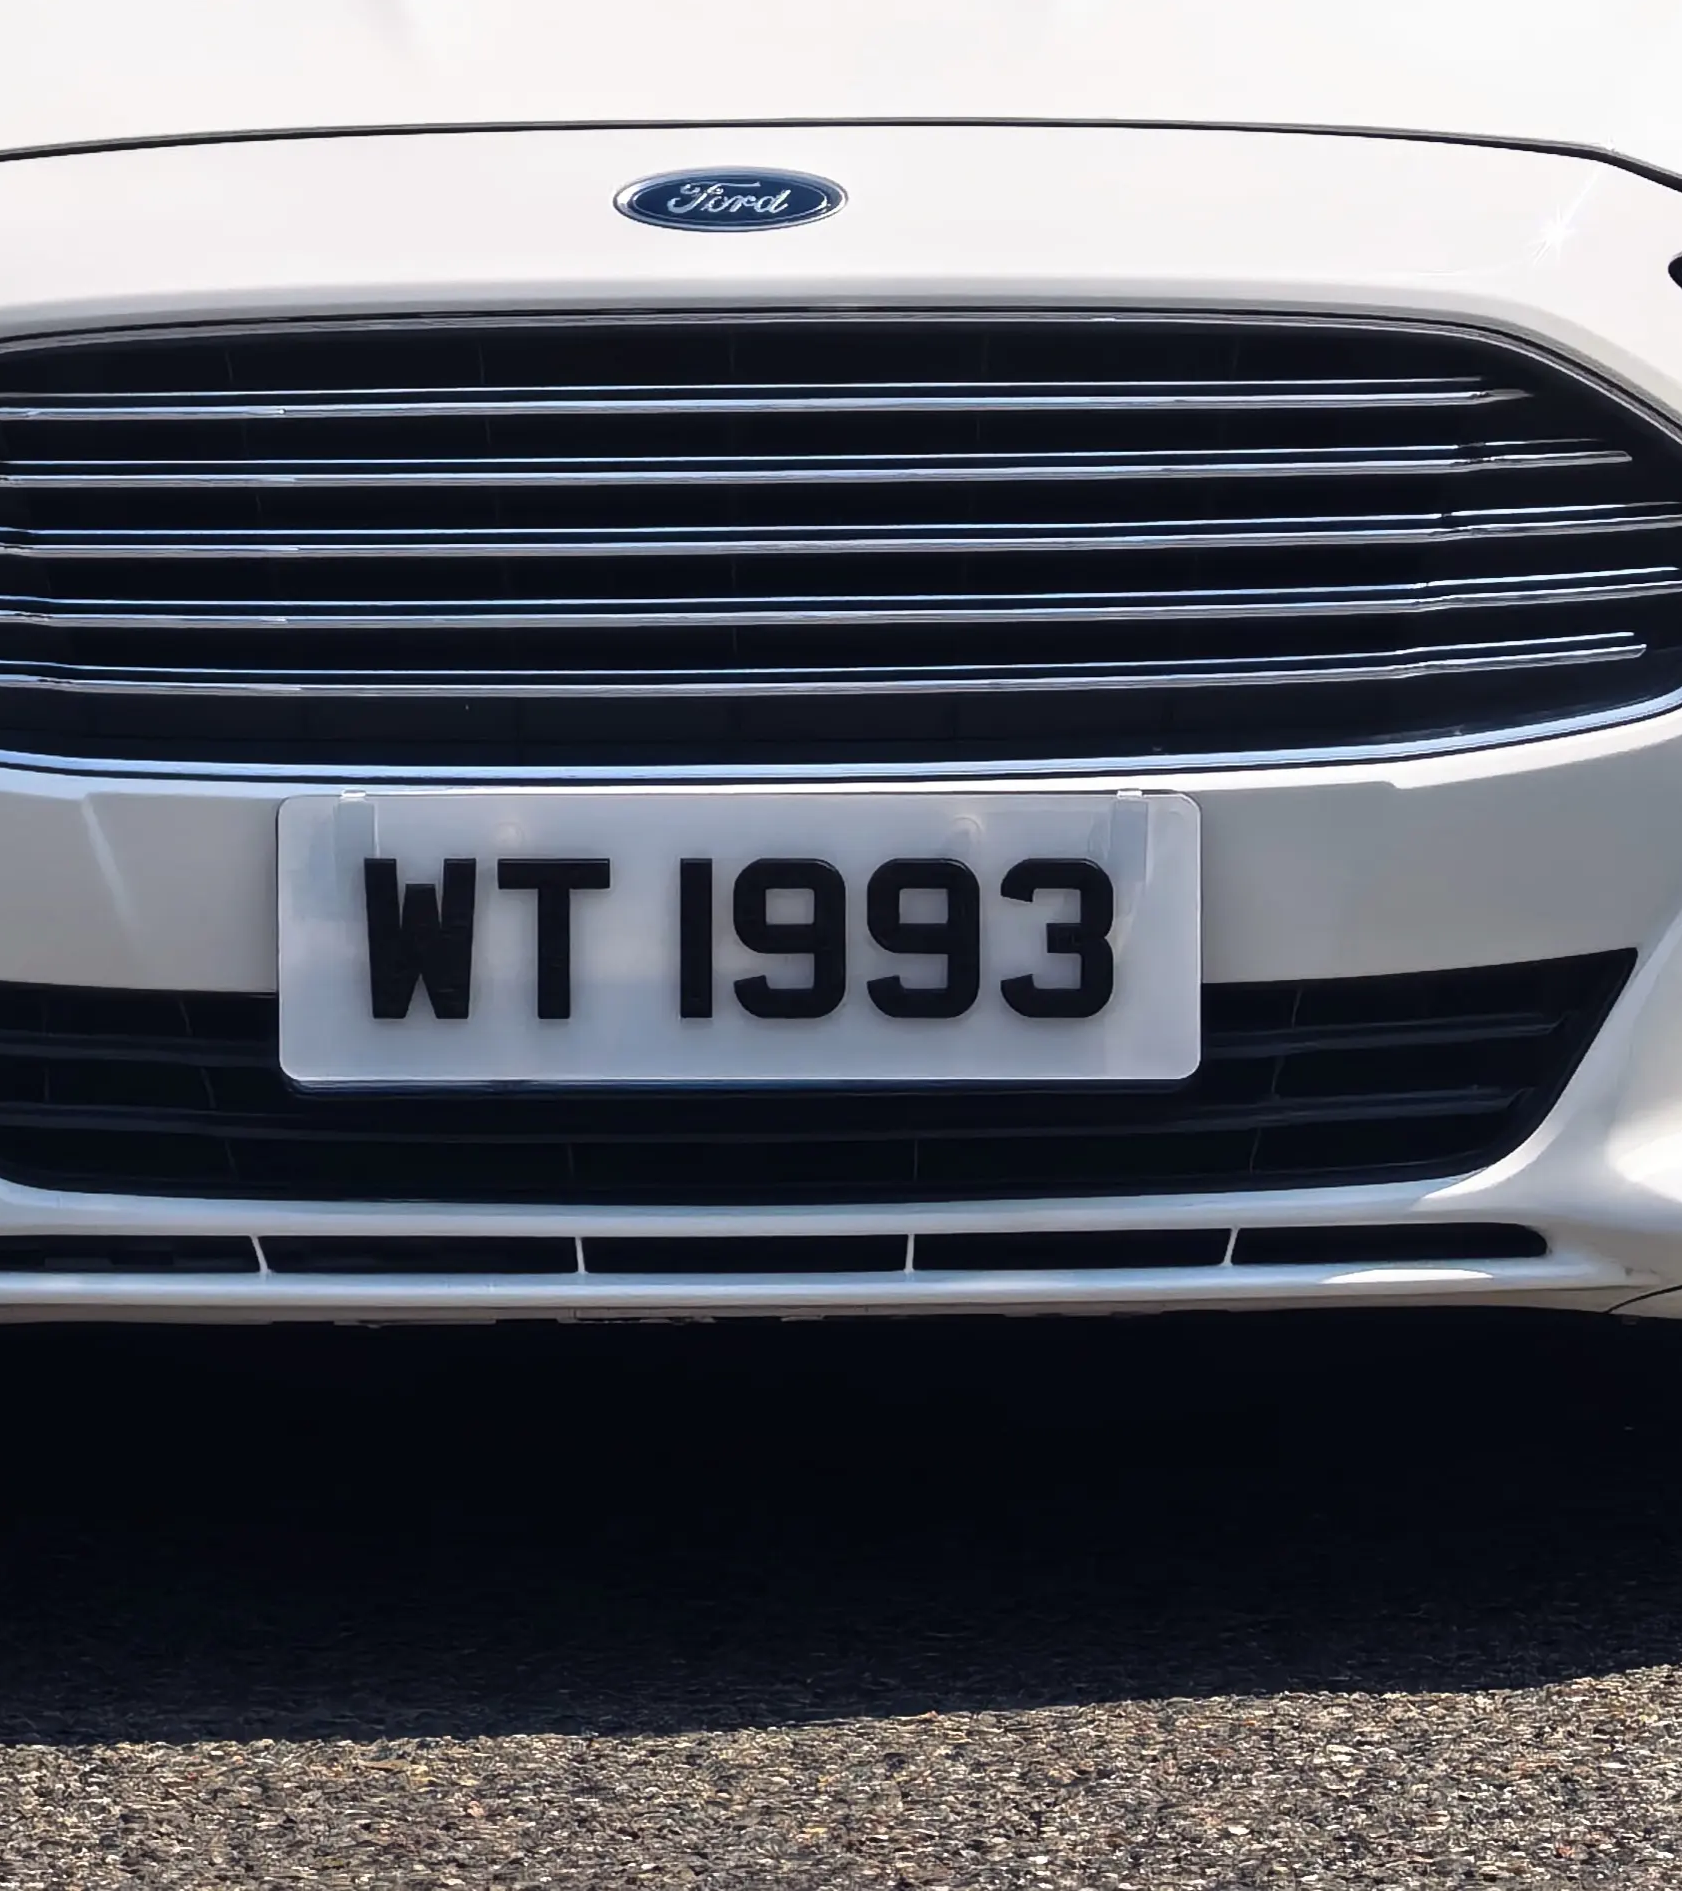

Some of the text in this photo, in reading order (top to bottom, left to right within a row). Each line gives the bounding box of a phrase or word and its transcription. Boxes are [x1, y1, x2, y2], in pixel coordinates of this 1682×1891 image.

[668, 181, 791, 214] Ford
[364, 858, 1114, 1020] WT 1993
